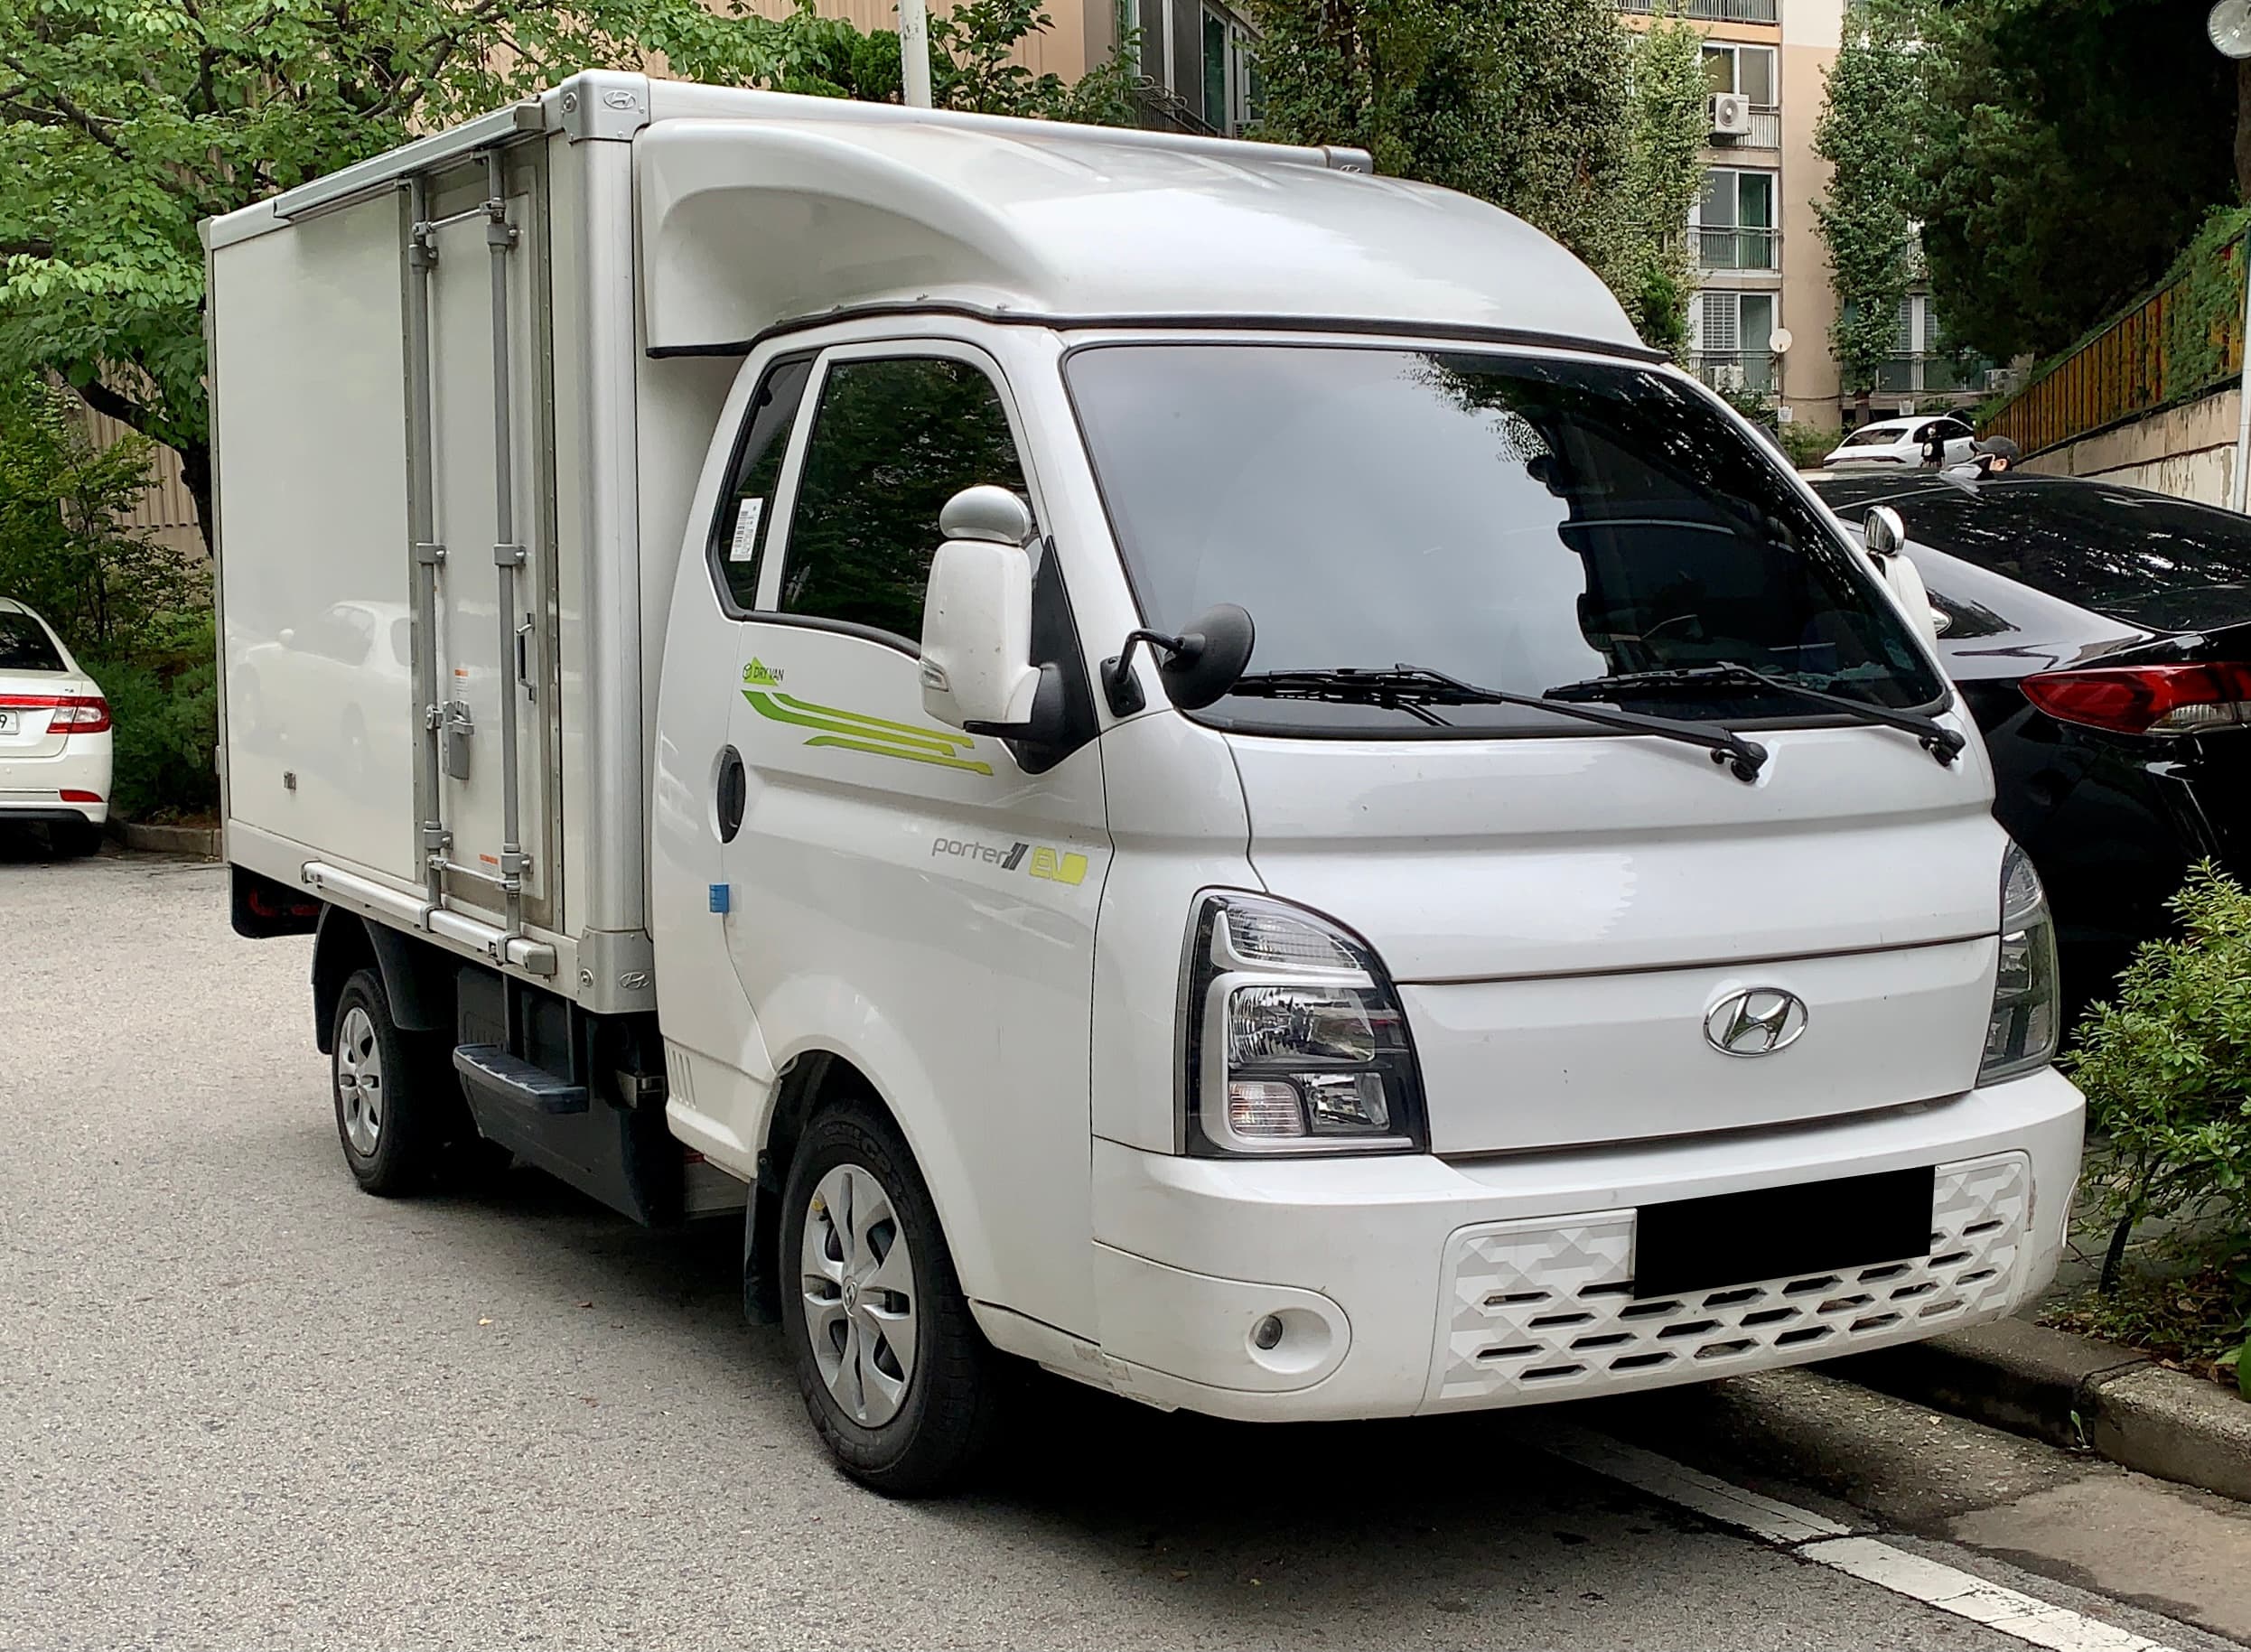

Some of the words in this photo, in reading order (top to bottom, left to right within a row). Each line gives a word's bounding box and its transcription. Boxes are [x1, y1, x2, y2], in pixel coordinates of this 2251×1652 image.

[753, 667, 769, 679] DRY
[769, 667, 785, 682] VAN
[1029, 846, 1088, 886] EV
